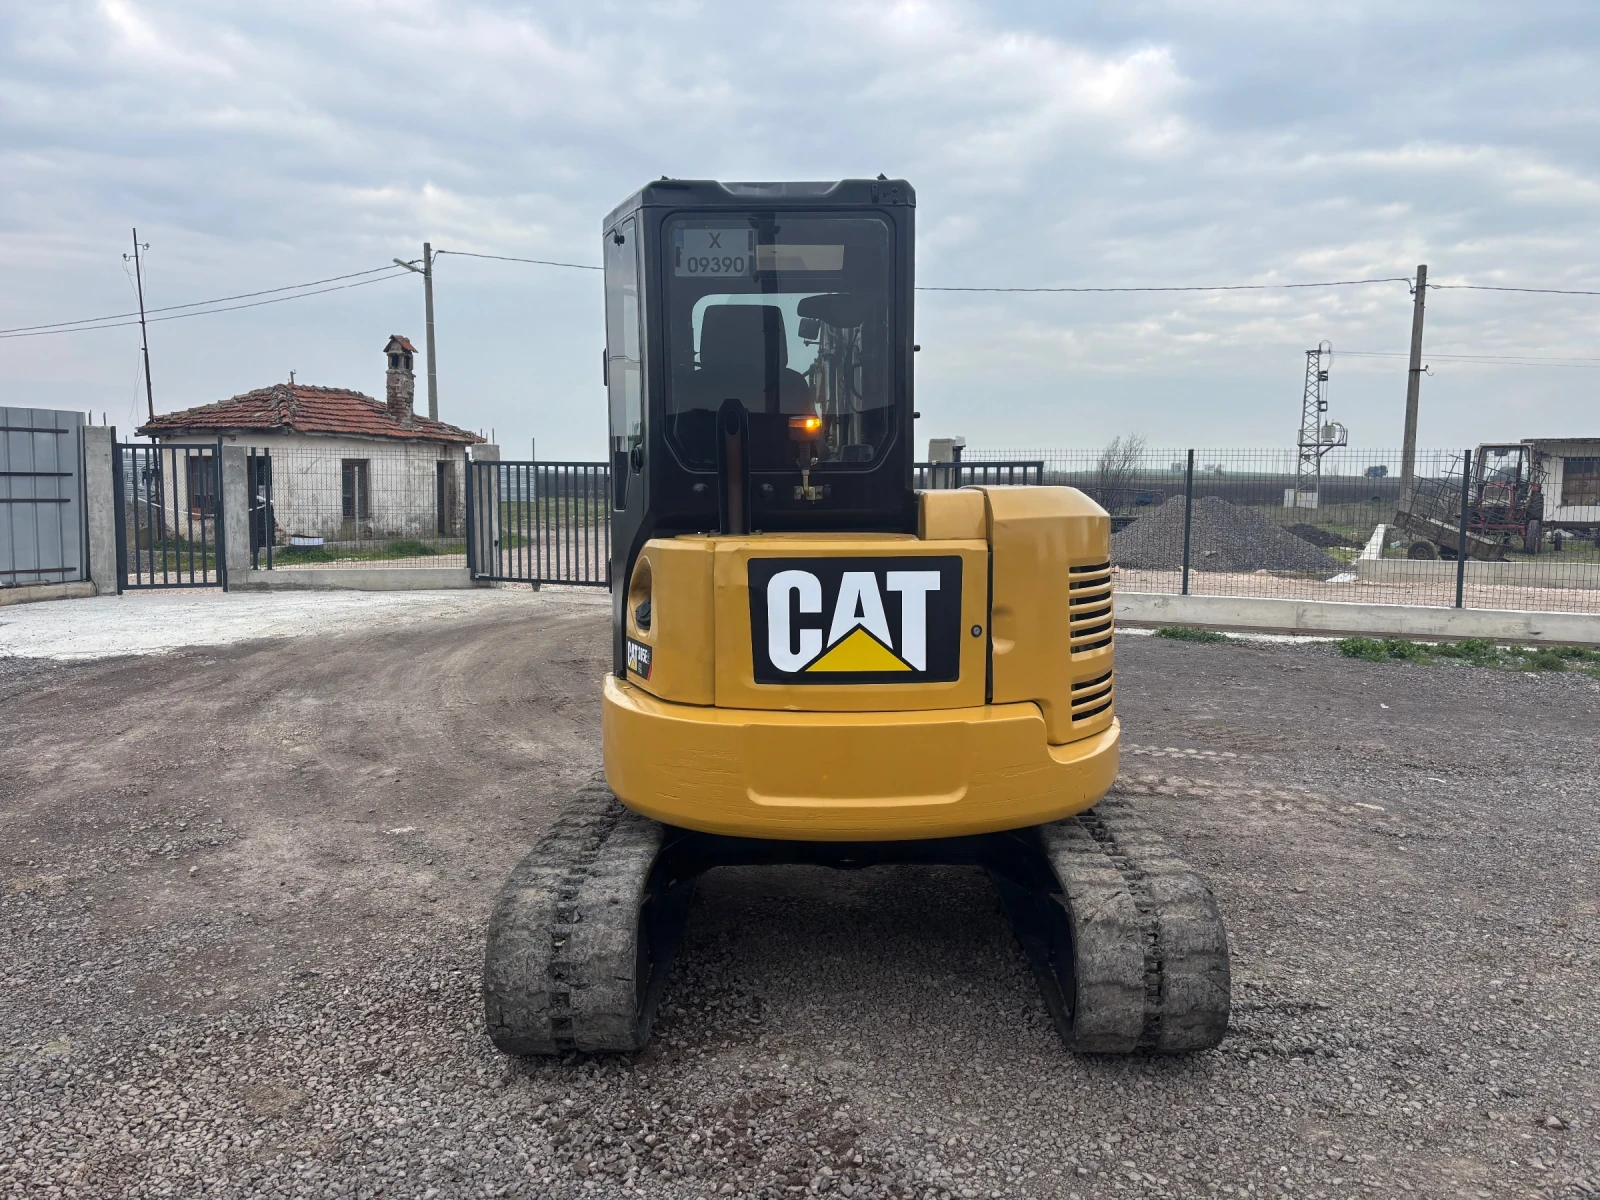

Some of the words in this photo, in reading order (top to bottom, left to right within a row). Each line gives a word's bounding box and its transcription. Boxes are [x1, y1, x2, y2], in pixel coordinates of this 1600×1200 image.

[709, 232, 721, 248] X
[687, 256, 745, 273] 09390
[767, 570, 941, 673] CAT
[627, 640, 638, 671] CAT
